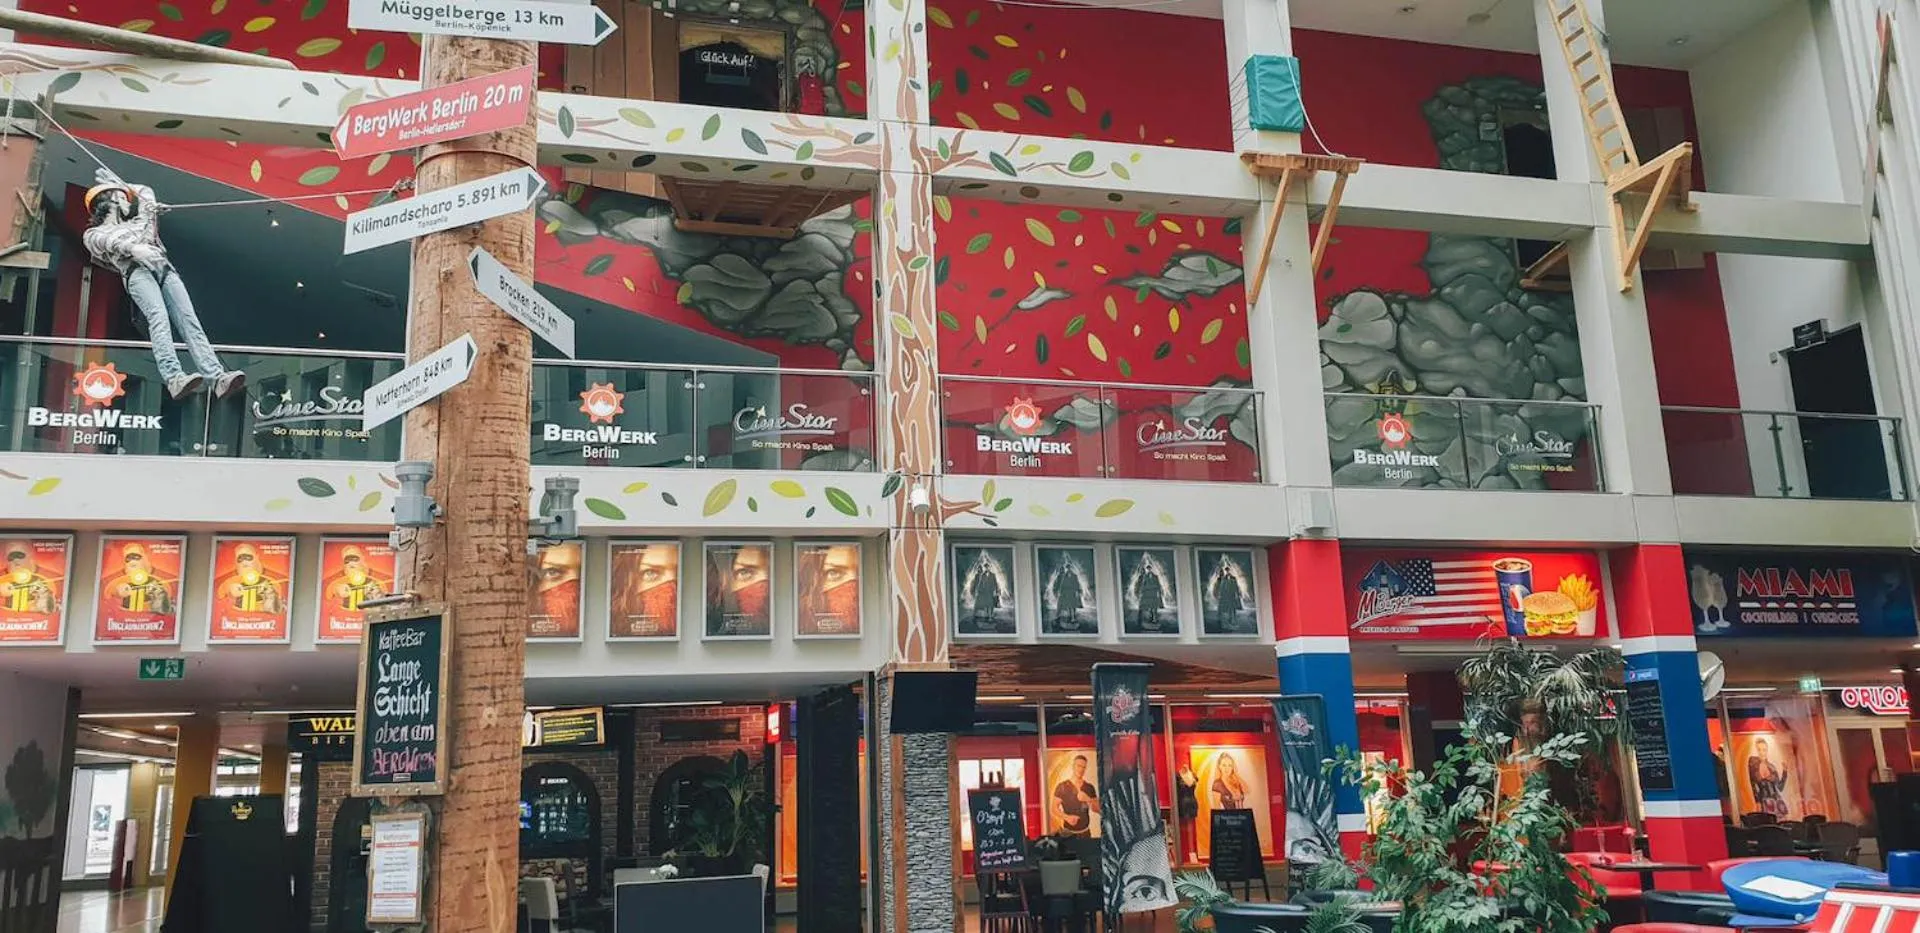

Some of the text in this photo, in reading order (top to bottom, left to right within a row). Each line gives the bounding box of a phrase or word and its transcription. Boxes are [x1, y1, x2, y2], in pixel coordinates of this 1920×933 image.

[381, 0, 564, 27] Müggelberge 13 km
[434, 20, 512, 32] Berlin-Köpenick
[353, 84, 523, 137] BergWerk Berlin 20 m
[352, 180, 521, 235] Kilimandscharo 5.891 km
[252, 386, 364, 420] CineSta
[734, 403, 839, 433] CineStar
[1137, 417, 1228, 445] CineStar
[72, 429, 117, 446] Berlin
[322, 428, 343, 437] Kino
[793, 441, 811, 450] Kino
[582, 445, 619, 460] Berlin
[1010, 454, 1042, 469] Berlin
[1384, 467, 1413, 480] Berlin
[1737, 567, 1854, 598] MIAMI
[378, 653, 422, 686] Lange
[374, 680, 432, 721] Schicht
[375, 720, 434, 744] oben am
